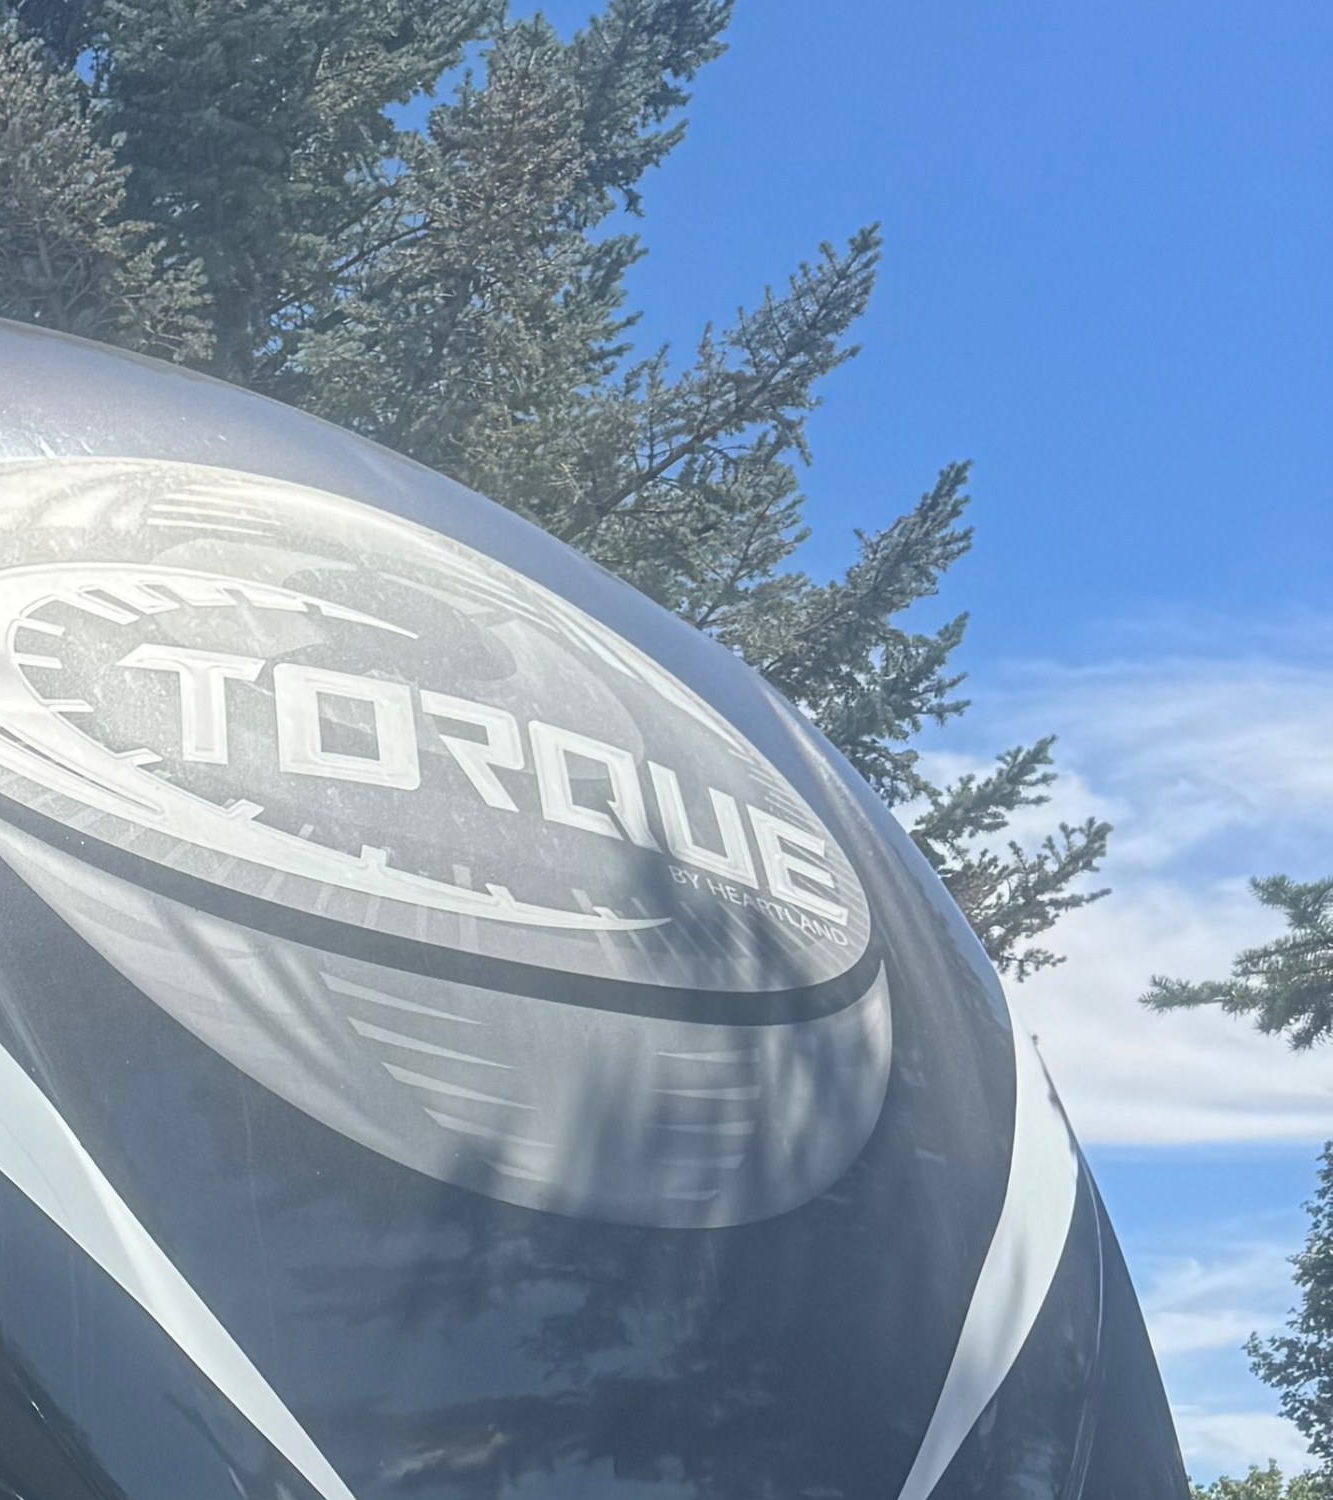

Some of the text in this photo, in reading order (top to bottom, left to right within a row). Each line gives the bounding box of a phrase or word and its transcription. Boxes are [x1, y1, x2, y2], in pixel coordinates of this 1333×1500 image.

[117, 644, 848, 926] TORQUE
[669, 865, 848, 946] BY HEARTLAND
